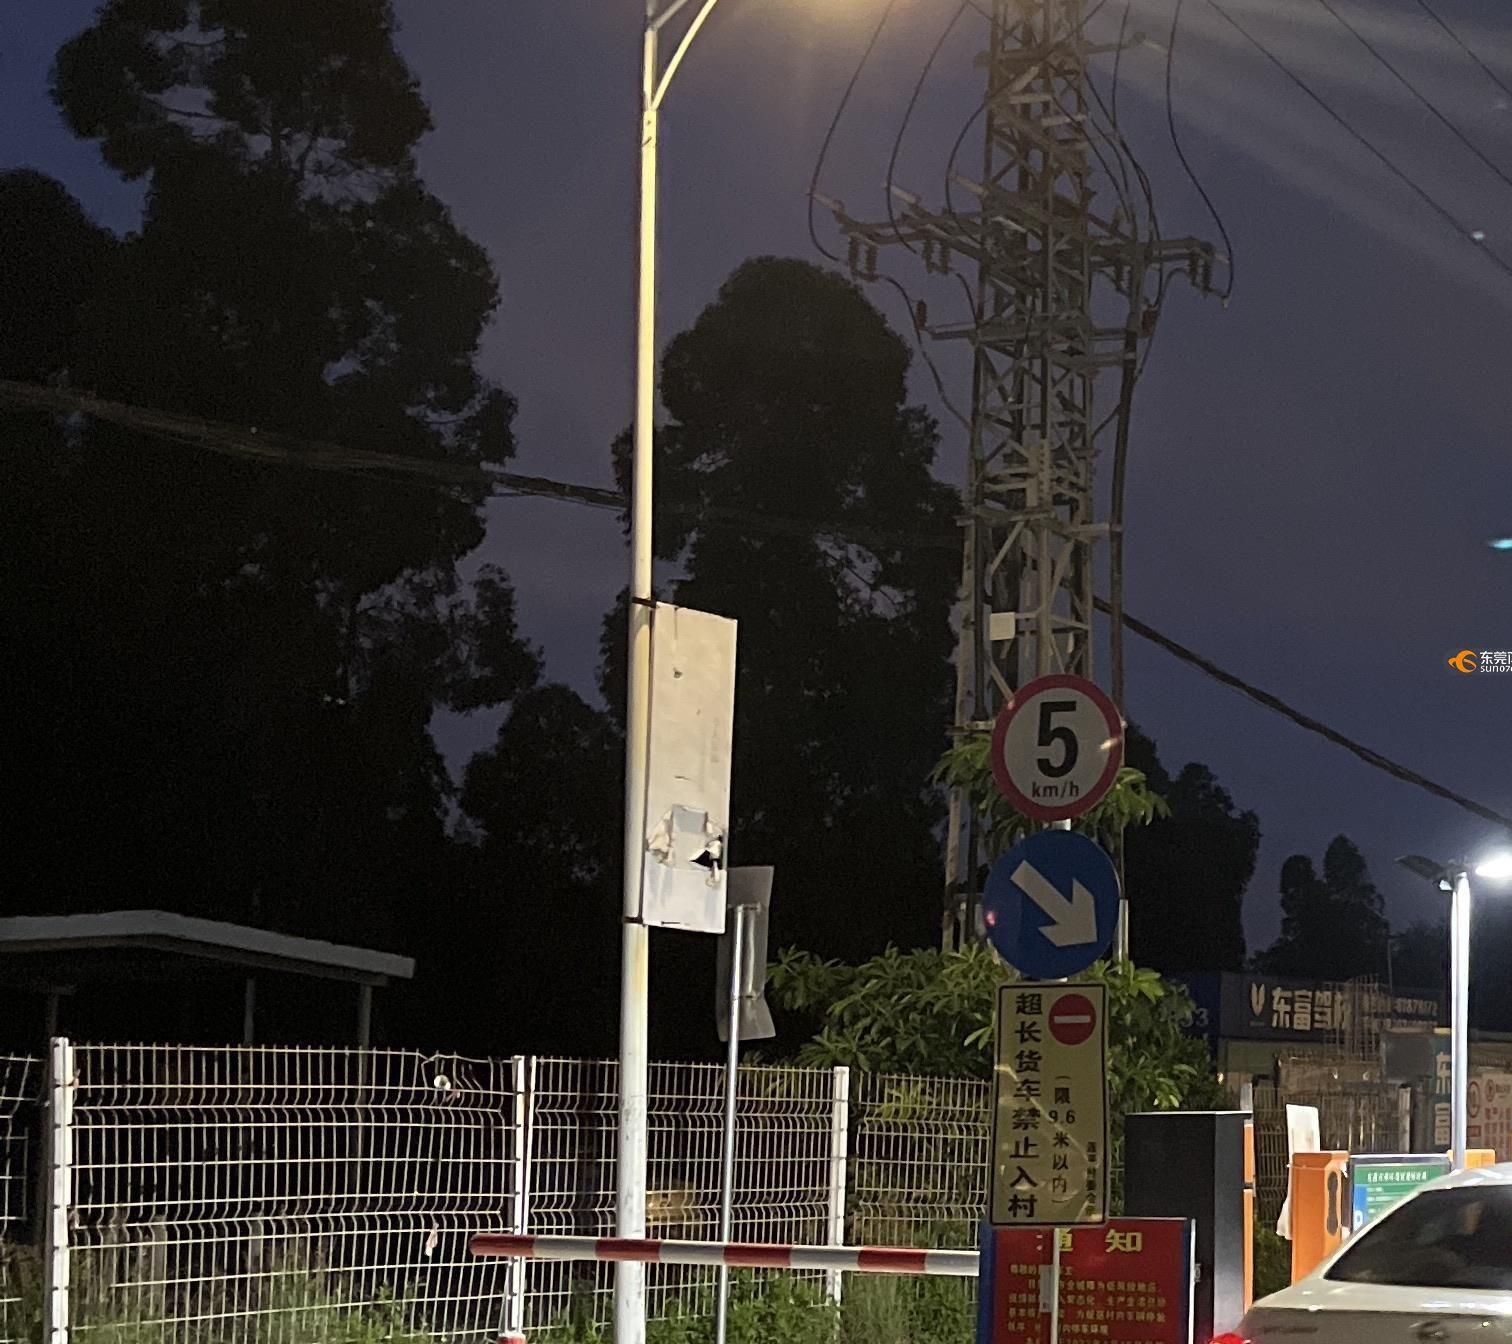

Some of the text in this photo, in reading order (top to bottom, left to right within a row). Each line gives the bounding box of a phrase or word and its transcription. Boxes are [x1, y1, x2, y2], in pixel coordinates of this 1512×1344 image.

[1037, 701, 1079, 778] 5
[1031, 780, 1080, 801] km/h
[1008, 993, 1043, 1218] 超长货车禁止入村
